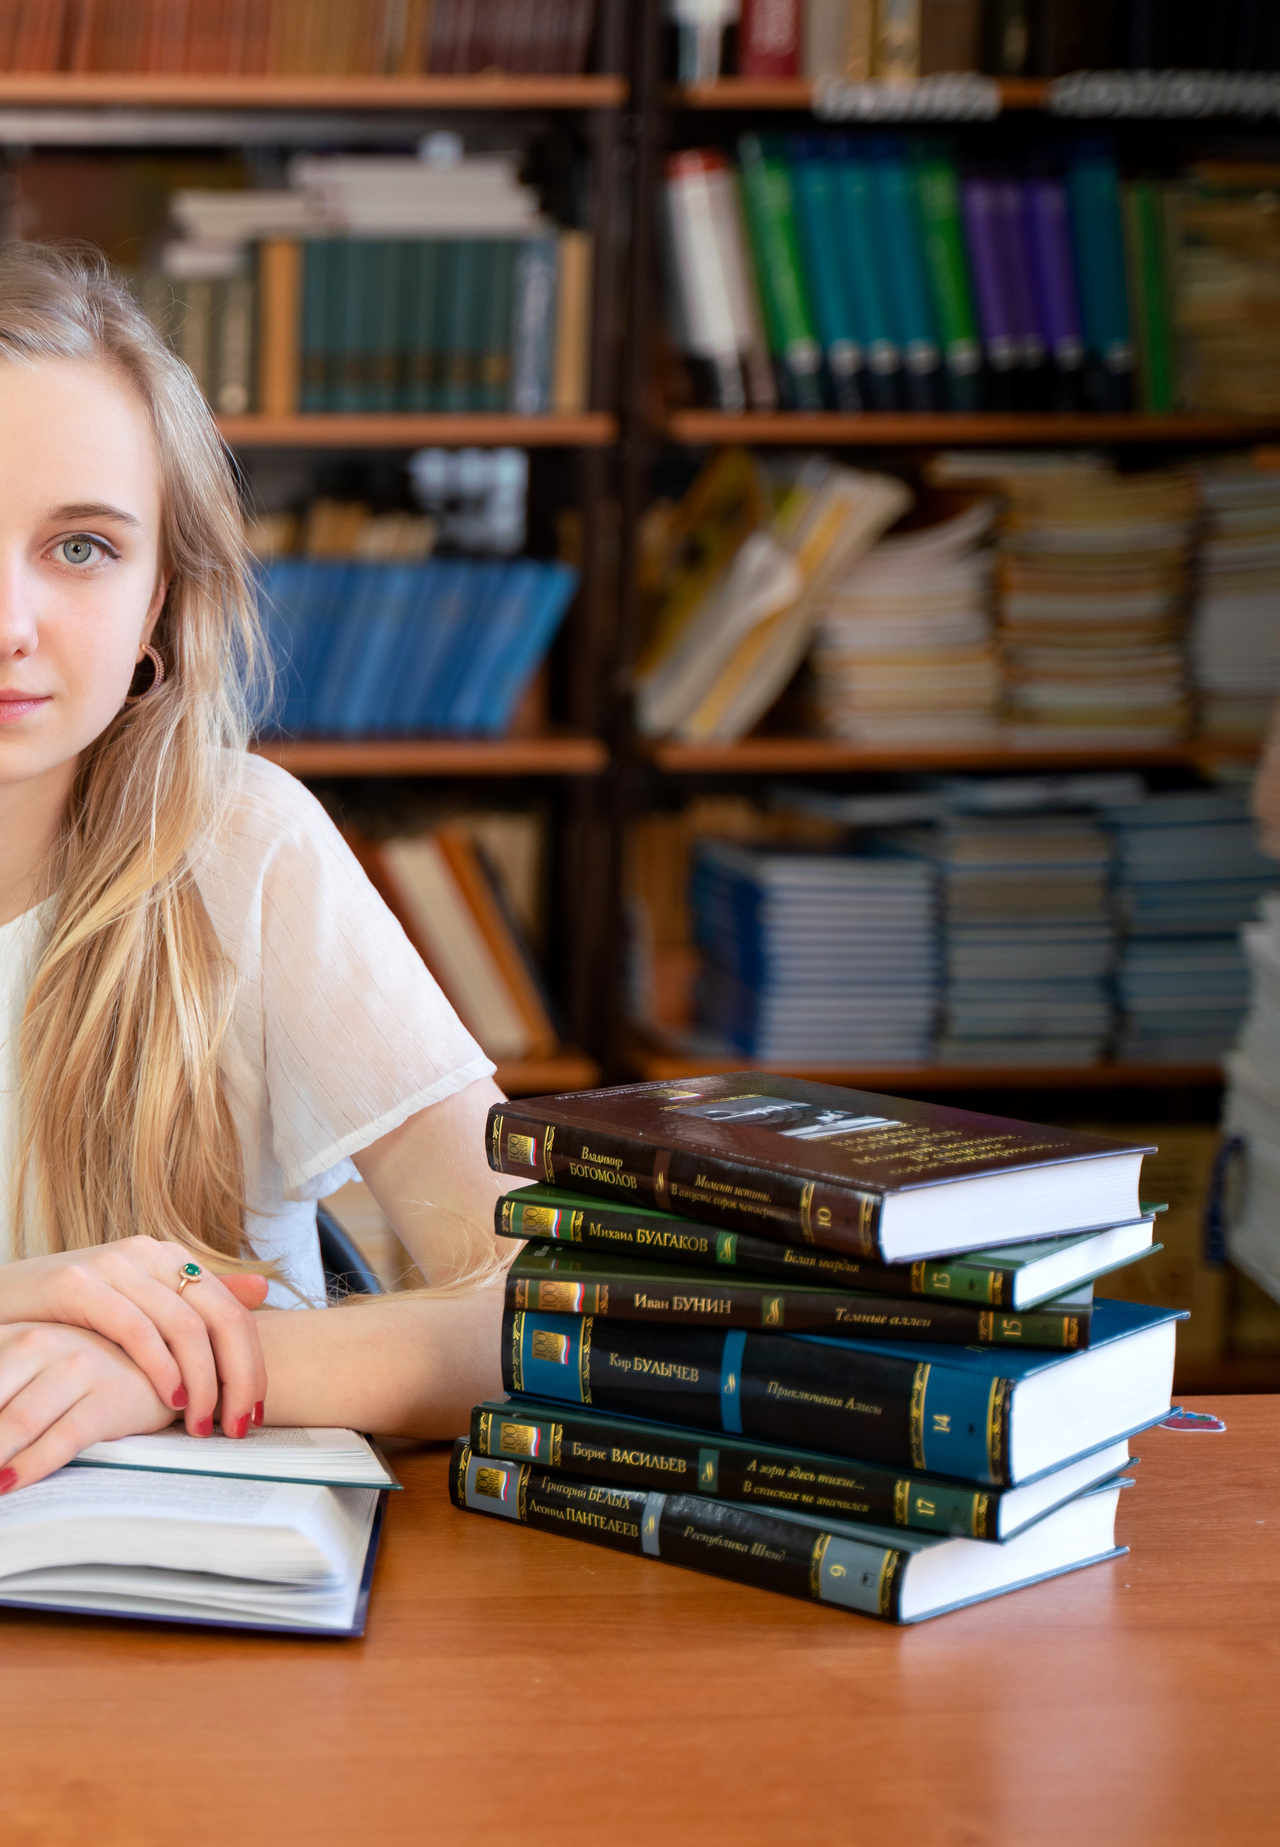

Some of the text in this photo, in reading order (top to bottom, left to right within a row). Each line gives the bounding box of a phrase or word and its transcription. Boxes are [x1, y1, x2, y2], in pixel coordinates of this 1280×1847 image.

[508, 1135, 520, 1161] 100
[580, 1146, 624, 1169] Владимир
[570, 1162, 638, 1189] БОГОМОЛОВ
[695, 1173, 734, 1196] Момент
[671, 1182, 678, 1196] В
[679, 1188, 712, 1204] августе
[712, 1196, 738, 1213] сорок
[523, 1207, 538, 1232] 100
[817, 1206, 833, 1228] 10
[589, 1222, 709, 1252] Михаил БУЛГАКОВ
[783, 1249, 860, 1274] Белая гвардия
[931, 1271, 951, 1290] 13
[541, 1282, 558, 1308] 100
[634, 1293, 732, 1314] Иван БУНИН
[835, 1307, 932, 1328] Темные аллеи
[1002, 1318, 1022, 1337] 15
[534, 1332, 548, 1358] 100
[609, 1352, 700, 1382] Кир БУЛЫЧЕВ
[766, 1381, 883, 1415] Приключения Алисы
[933, 1413, 951, 1433] 14
[502, 1424, 517, 1450] 100
[572, 1441, 687, 1473] Борис ВАСИЛЬЕВ
[477, 1468, 490, 1494] 100
[747, 1458, 866, 1491] А зори здесь тихие...
[540, 1475, 631, 1511] Григорий БЕЛЫХ
[742, 1481, 870, 1513] В списках не значился
[528, 1499, 639, 1537] Леонид ПАНТЕЛЕЕВ
[916, 1497, 936, 1517] 17
[683, 1525, 786, 1562] Республика Шкид
[829, 1564, 847, 1578] 9
